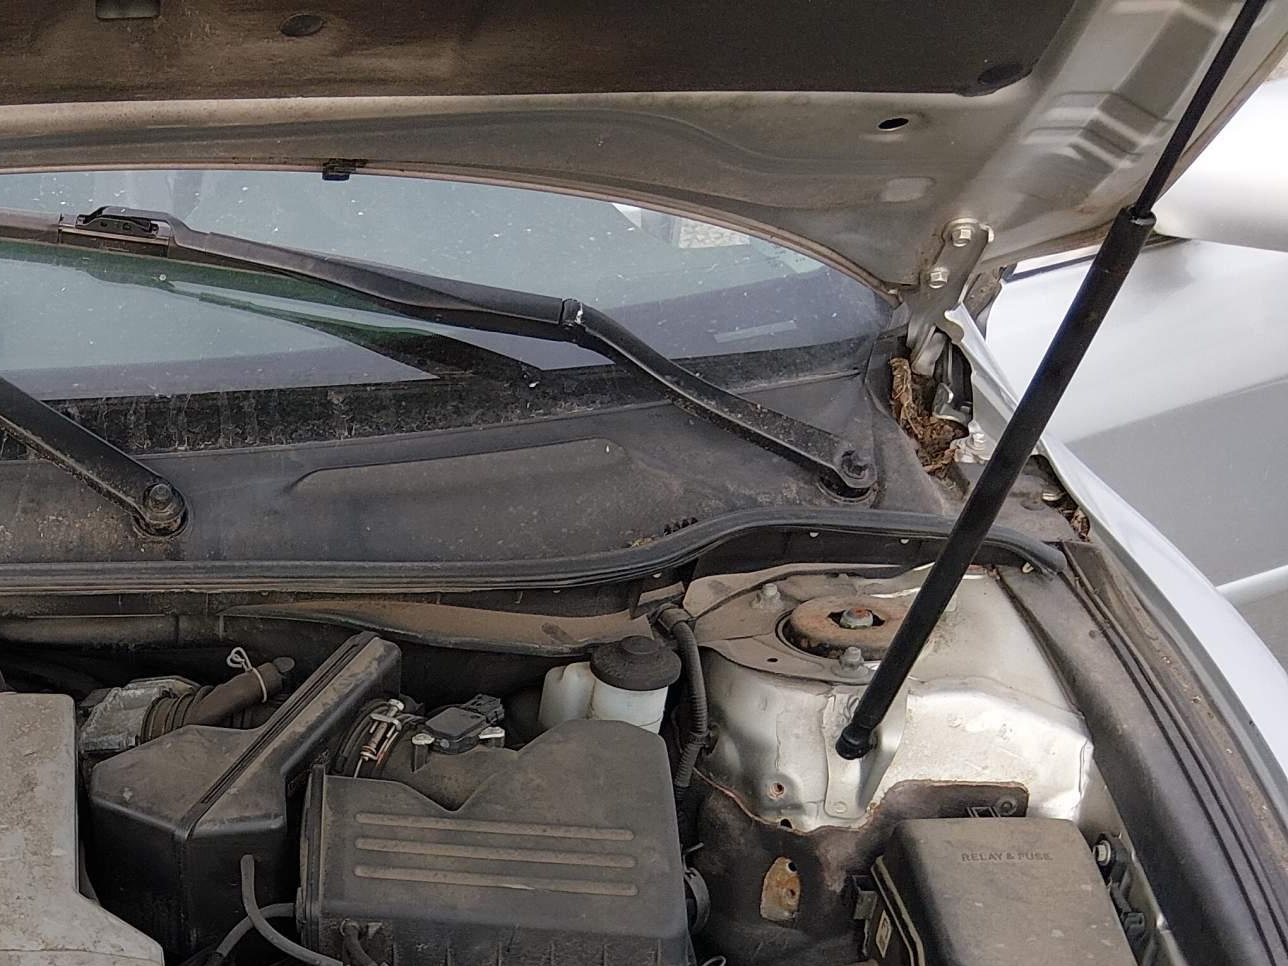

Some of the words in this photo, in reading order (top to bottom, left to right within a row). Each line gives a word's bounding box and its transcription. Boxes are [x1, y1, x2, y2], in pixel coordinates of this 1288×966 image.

[961, 851, 1003, 862] RELAY
[1006, 852, 1015, 861] &
[1016, 852, 1054, 862] FUSE
